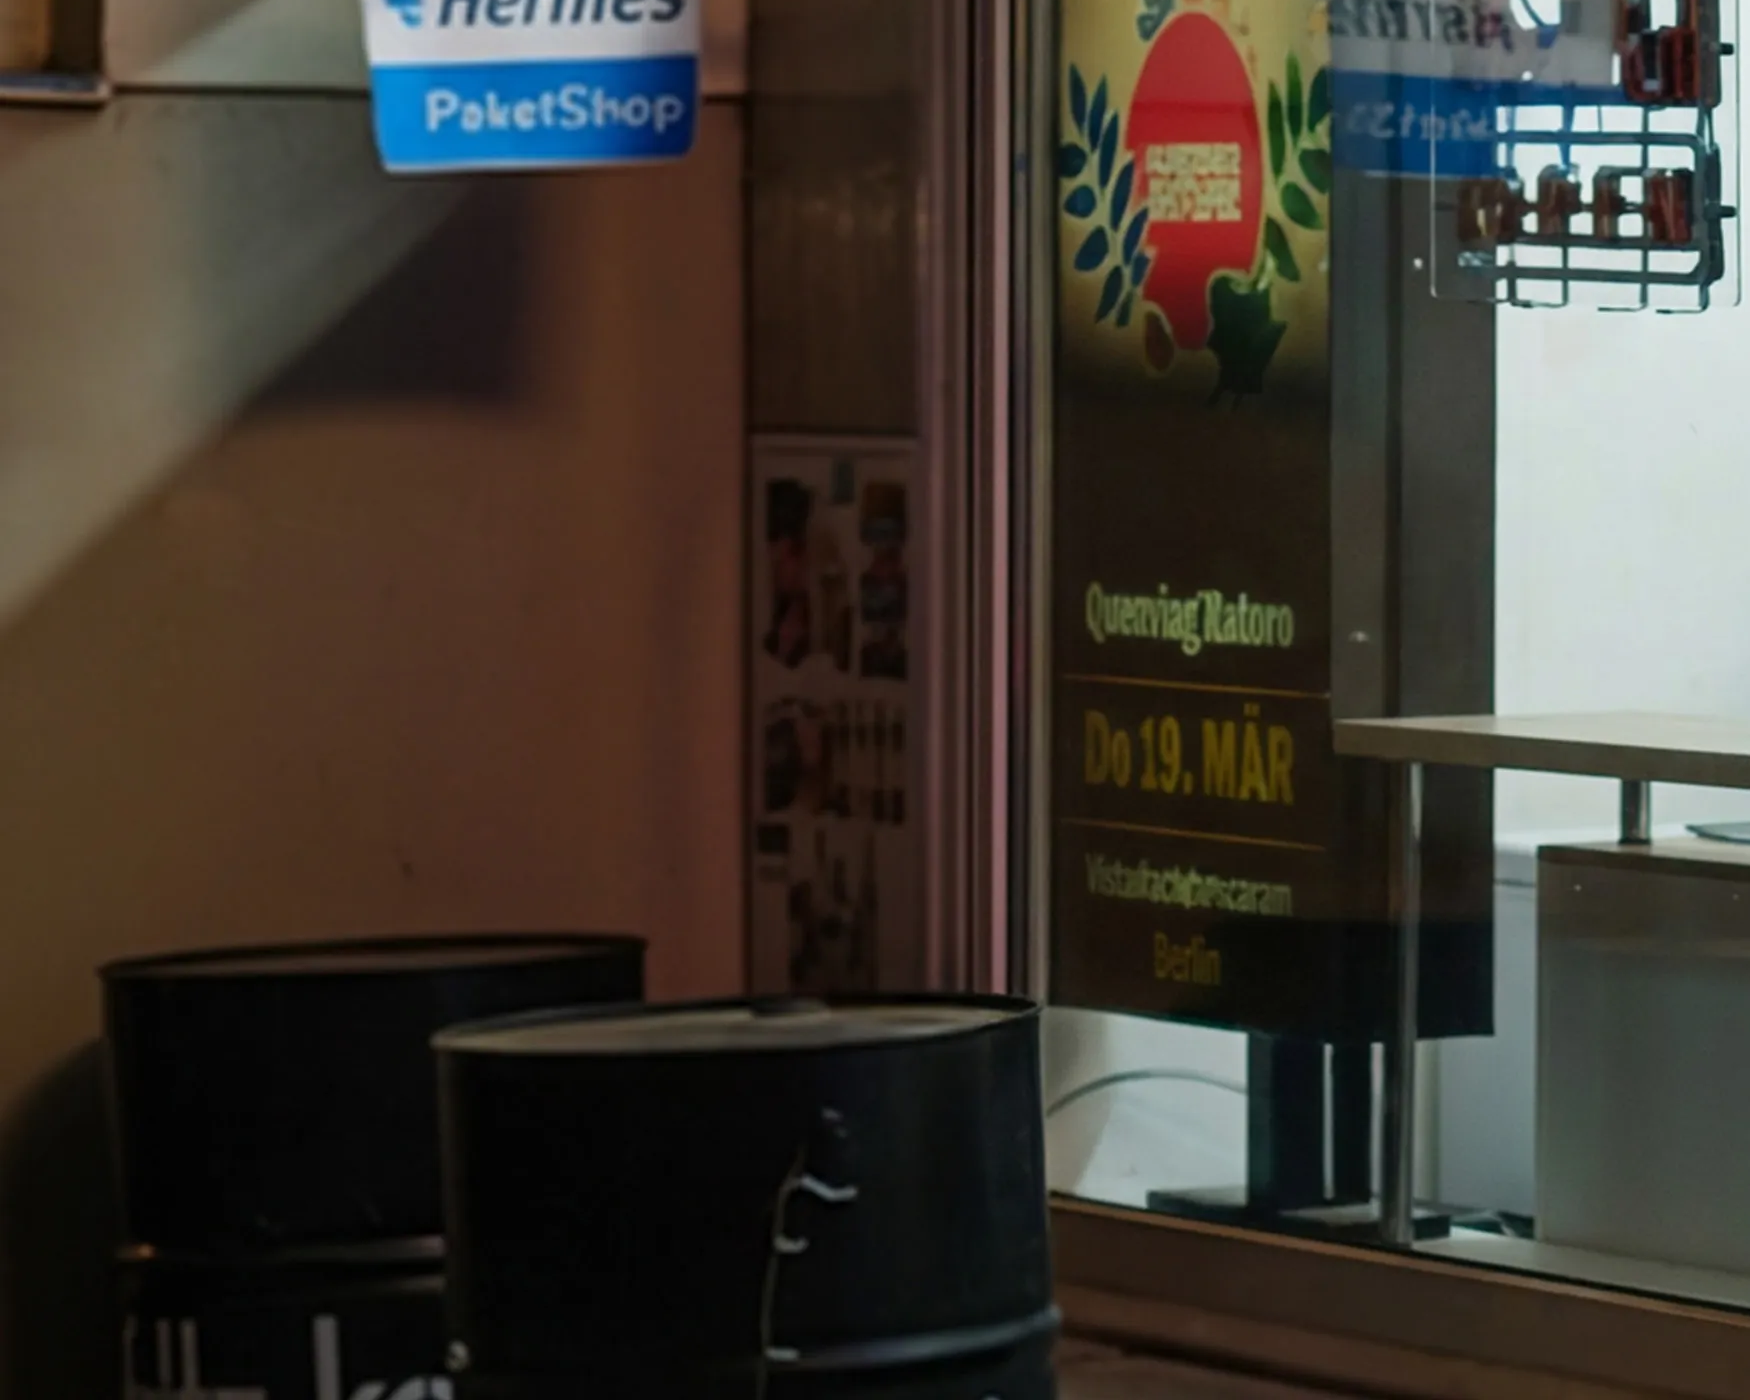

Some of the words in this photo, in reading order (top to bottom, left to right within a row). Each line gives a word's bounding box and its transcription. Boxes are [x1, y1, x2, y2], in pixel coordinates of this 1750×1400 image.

[425, 83, 685, 133] PaketShop
[1084, 709, 1132, 787] Do
[1139, 713, 1194, 796] 19.
[1202, 702, 1294, 805] MÄR
[1153, 931, 1222, 986] Berlin
